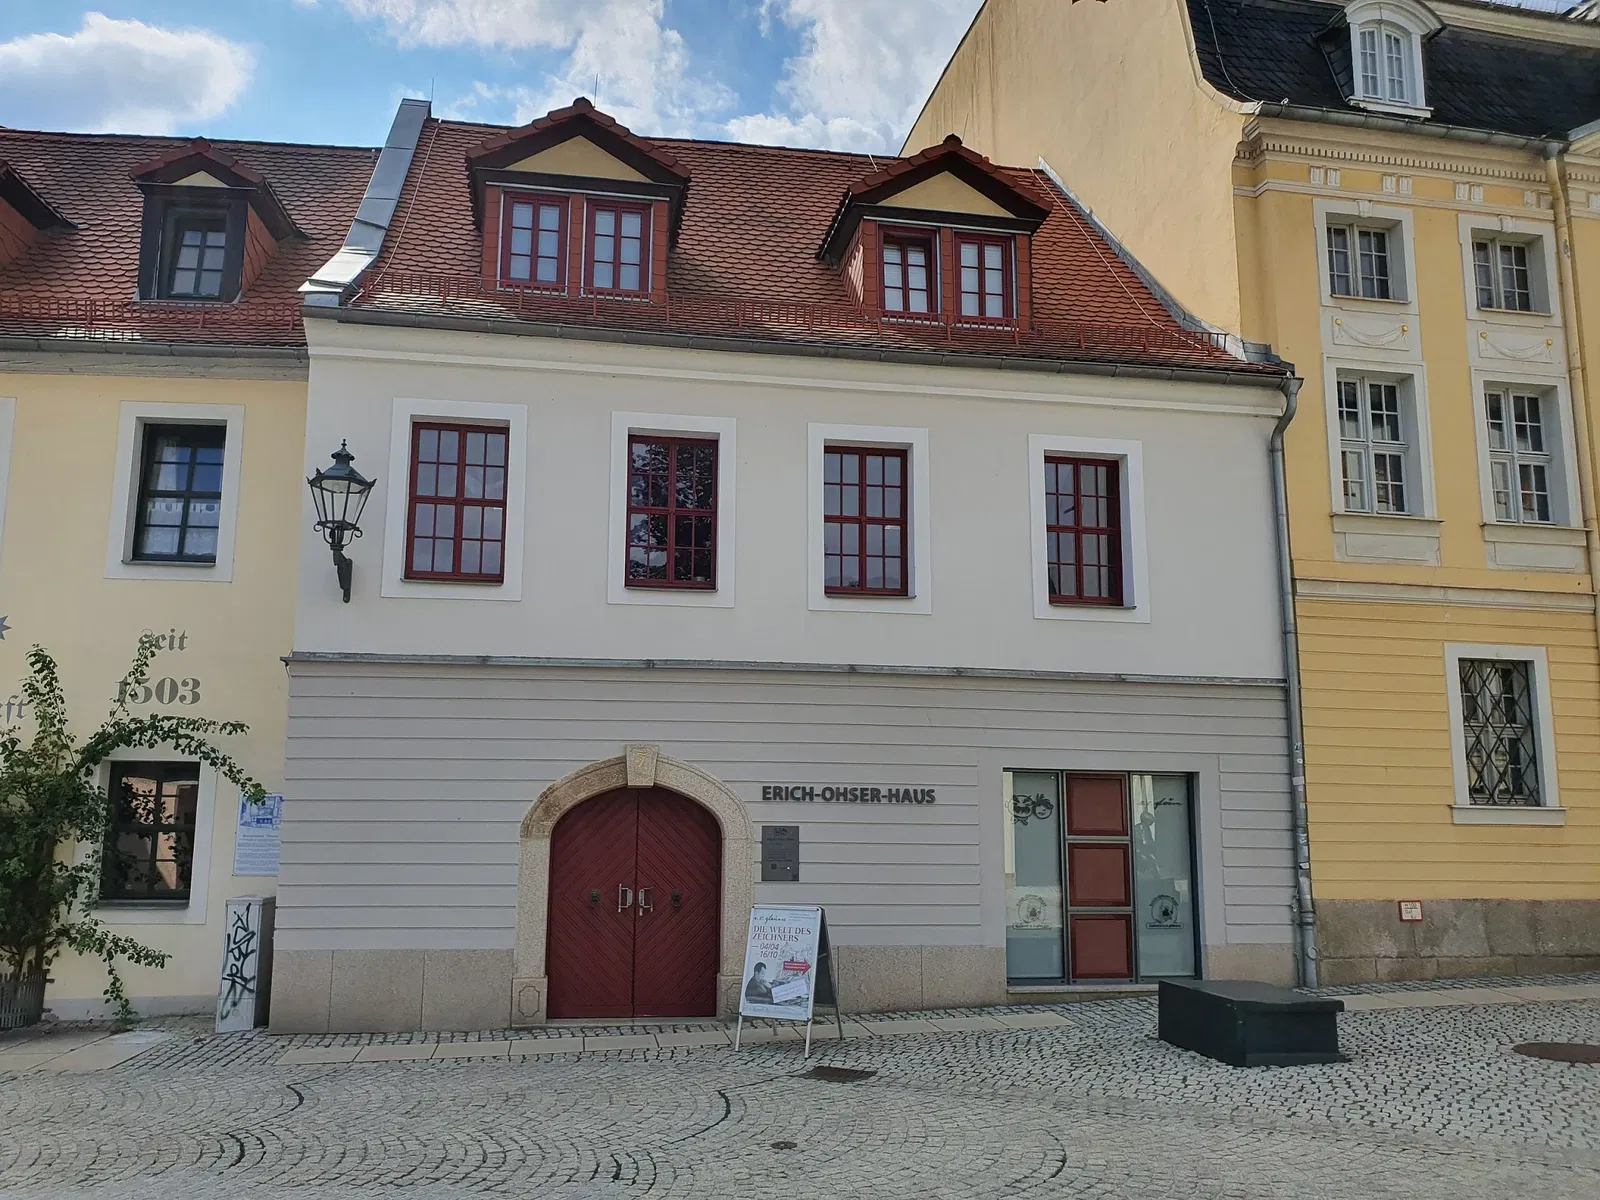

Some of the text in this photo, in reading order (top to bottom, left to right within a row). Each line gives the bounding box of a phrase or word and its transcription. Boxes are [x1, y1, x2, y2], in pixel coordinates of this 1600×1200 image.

[115, 676, 201, 705] 1503
[0, 694, 27, 724] ft
[762, 785, 936, 804] ERICH-OHSER-HAUS
[752, 933, 799, 942] ZEICHNERS
[770, 926, 793, 934] WELT
[795, 927, 812, 935] DES
[759, 951, 778, 959] 16/10
